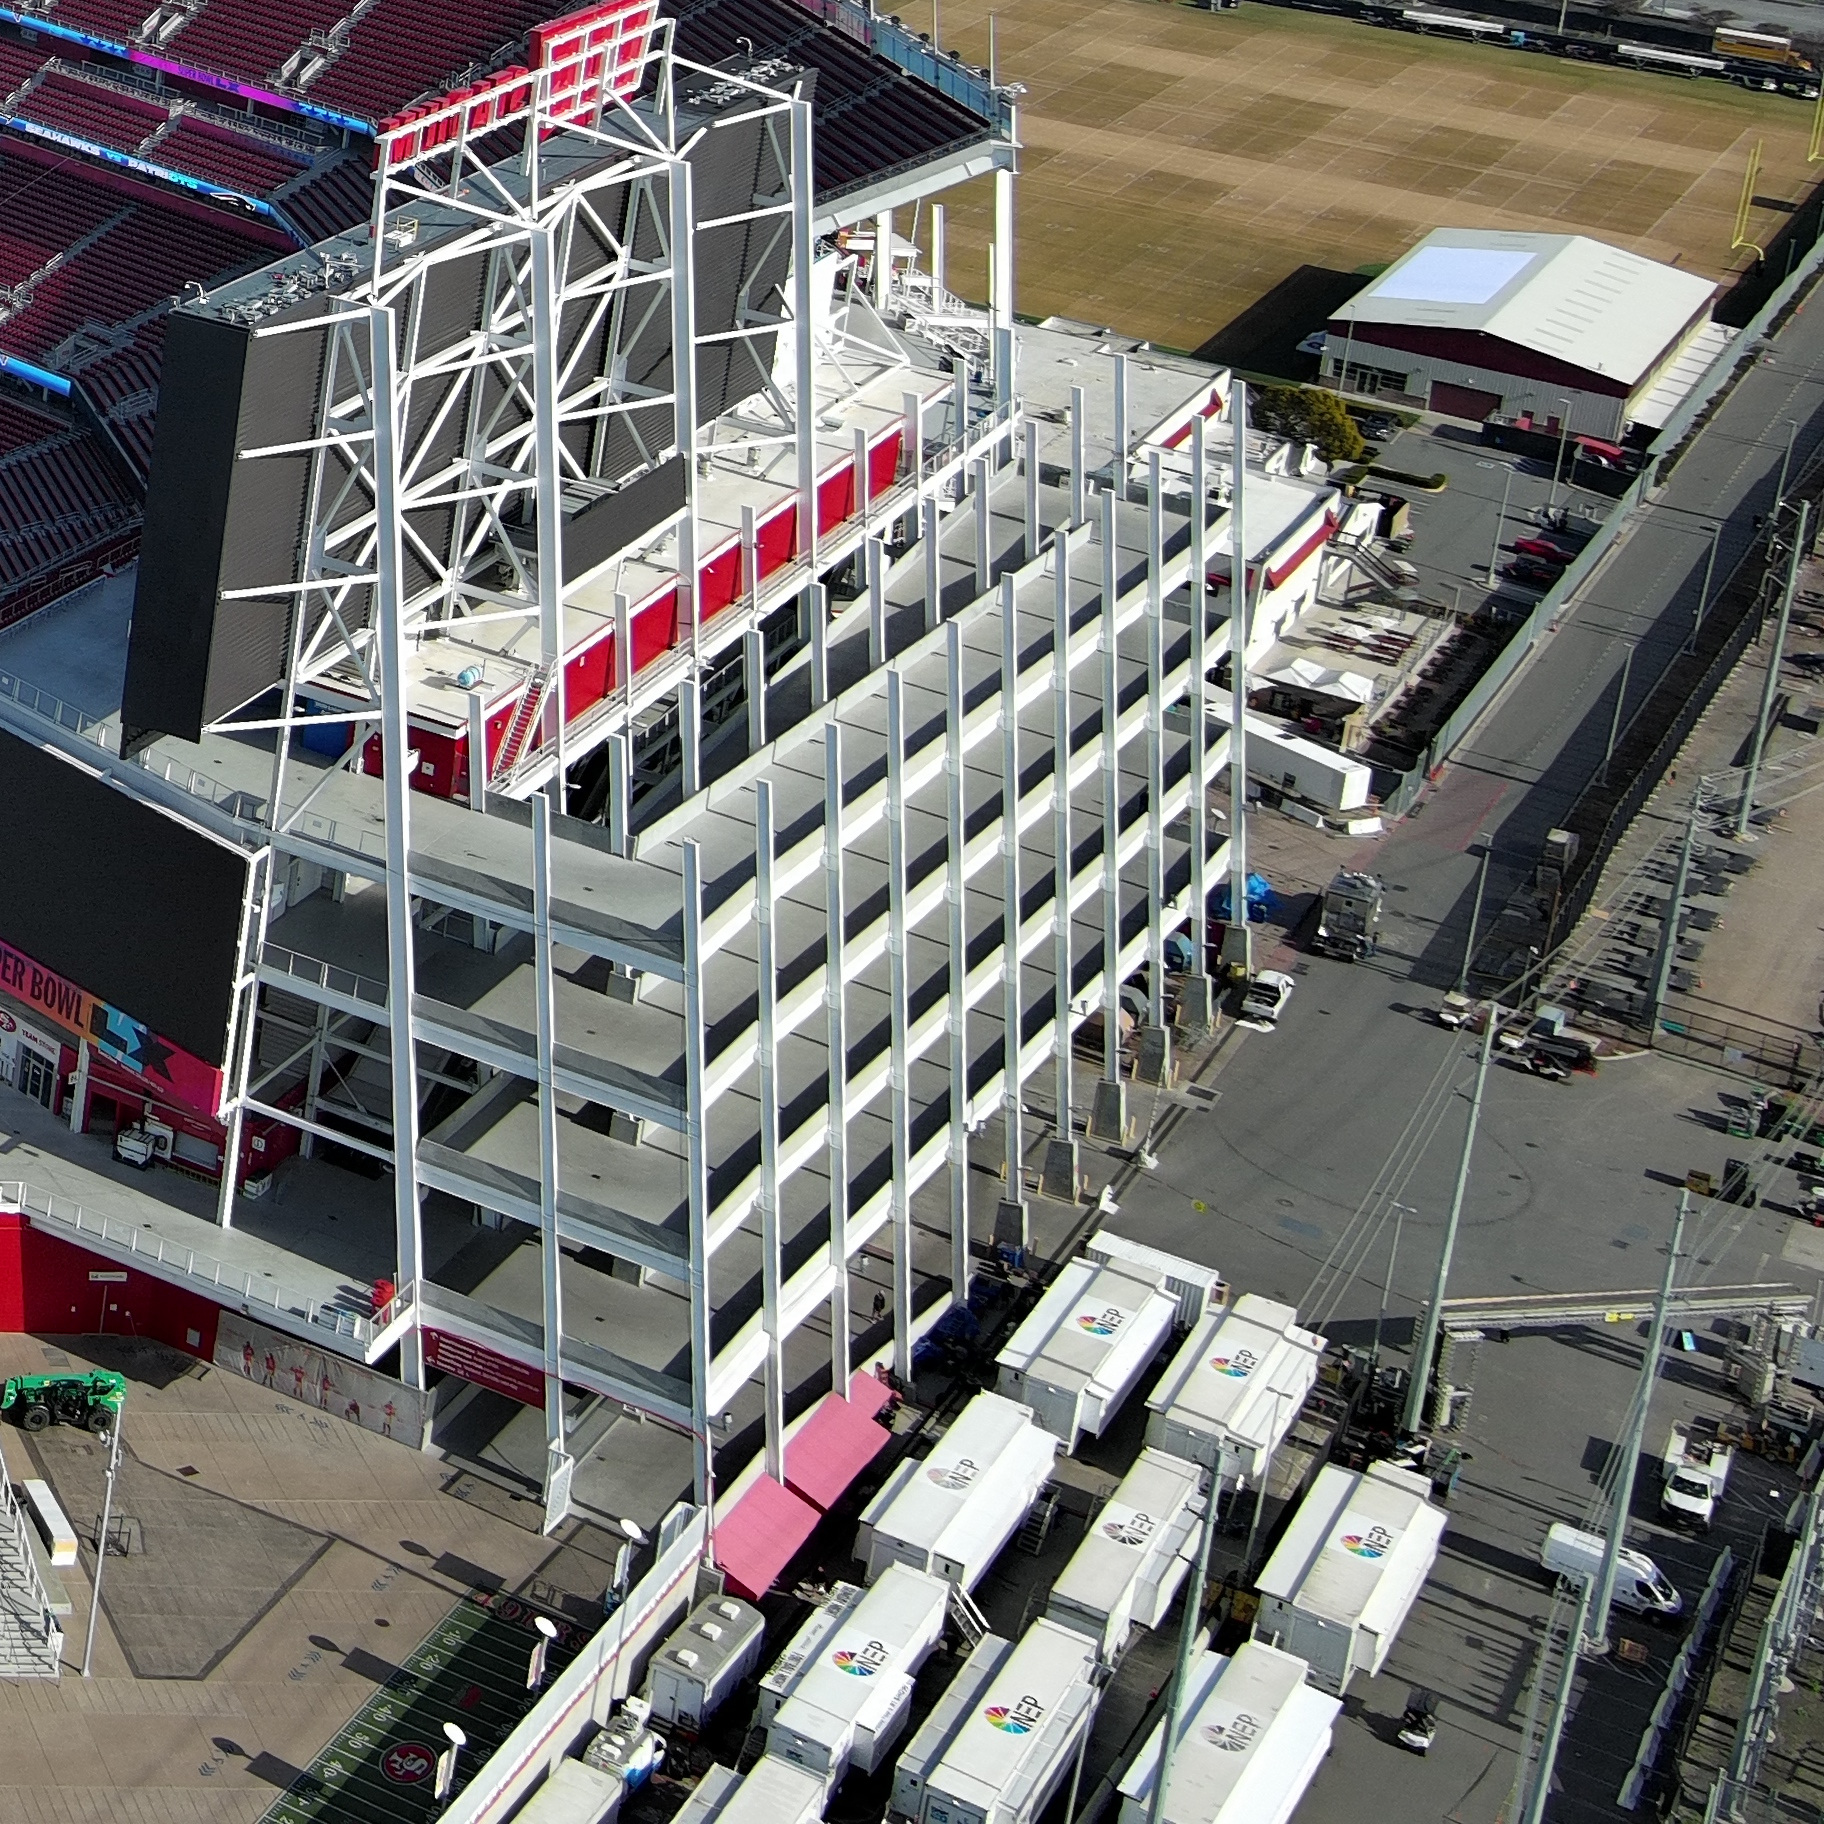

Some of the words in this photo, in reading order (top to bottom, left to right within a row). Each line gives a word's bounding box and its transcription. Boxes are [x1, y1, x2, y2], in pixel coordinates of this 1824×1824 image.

[212, 75, 239, 90] LX
[25, 124, 100, 156] SEAHAWKS
[128, 159, 198, 189] PATRIOTS
[30, 966, 85, 1028] BOWL
[22, 1029, 38, 1044] TEAM
[39, 1038, 56, 1055] STORE
[1097, 1308, 1126, 1334] NEP
[1230, 1349, 1259, 1377] NEP
[949, 1459, 980, 1486] NEP
[1126, 1513, 1157, 1537] NEP
[1362, 1525, 1394, 1554] NEP
[419, 1653, 441, 1672] 20
[855, 1640, 890, 1673] NEP
[373, 1703, 395, 1723] 40
[1010, 1694, 1045, 1728] NEP
[349, 1732, 372, 1749] 50
[1225, 1714, 1264, 1750] NEP
[324, 1759, 345, 1778] 40
